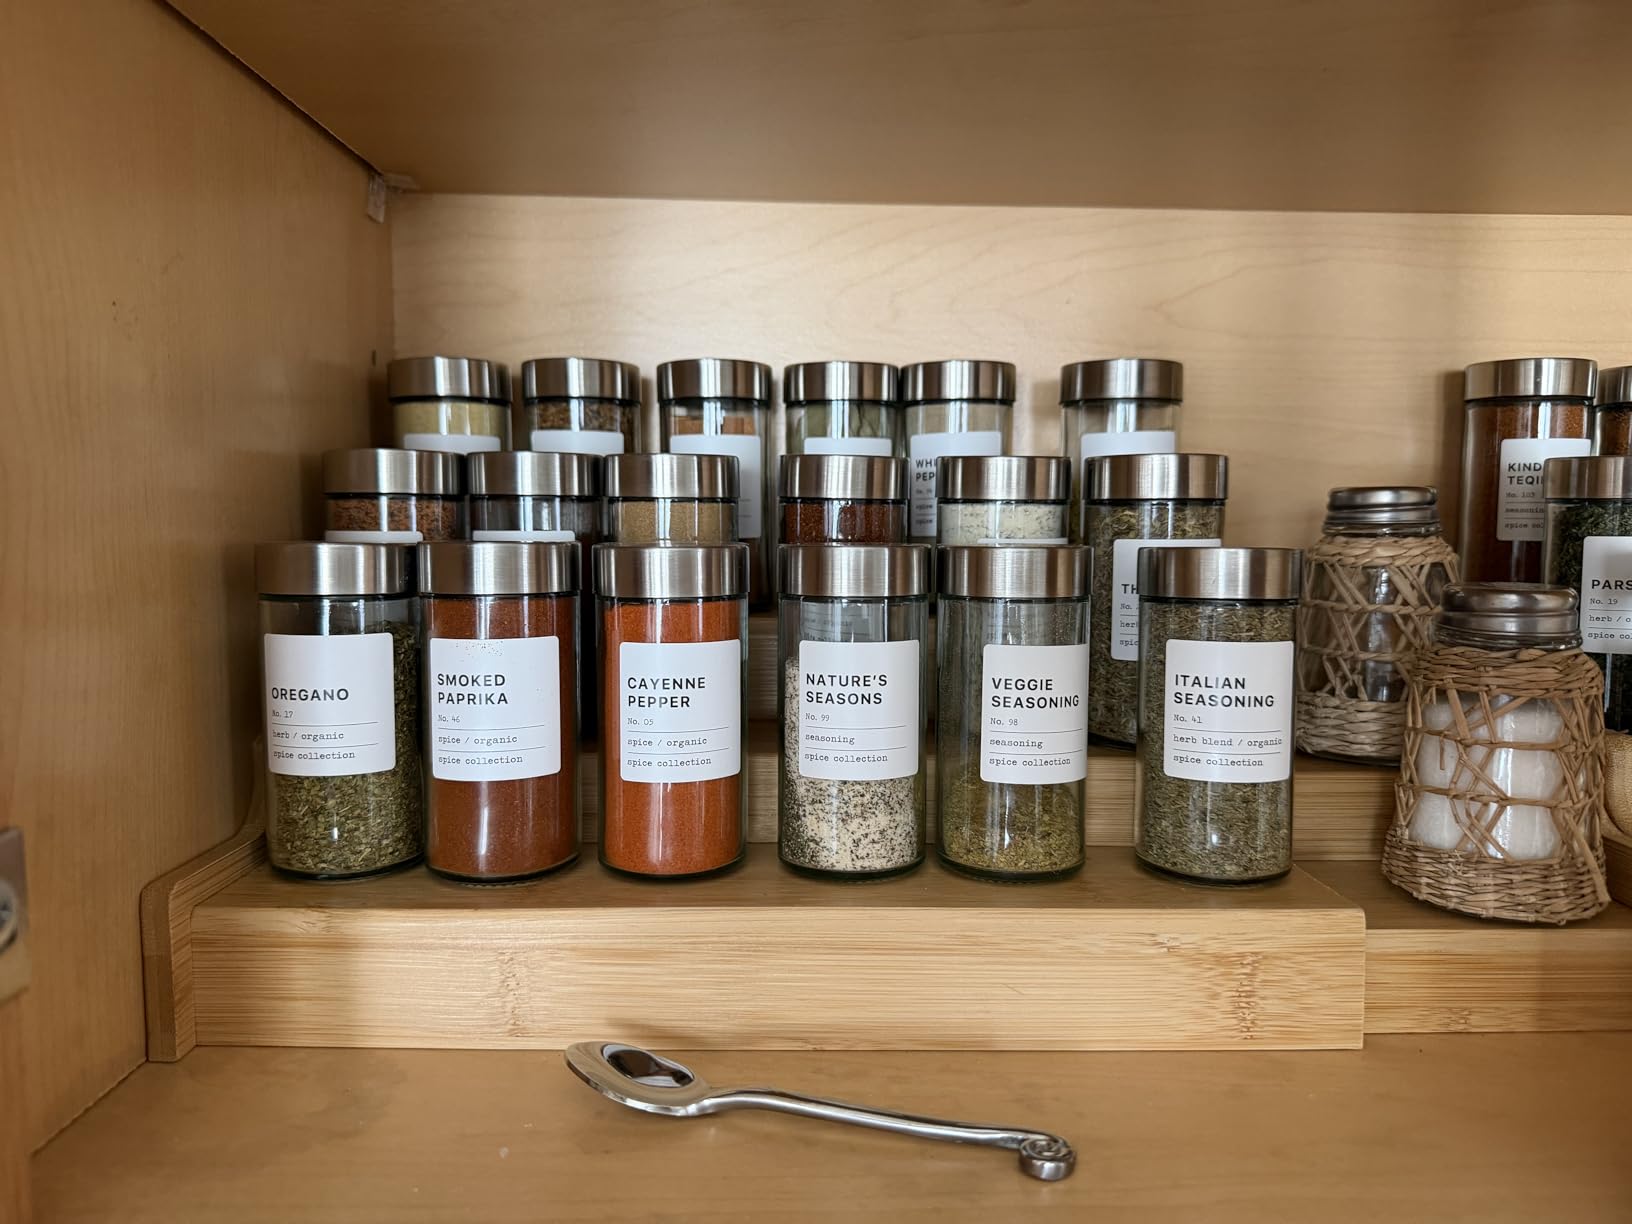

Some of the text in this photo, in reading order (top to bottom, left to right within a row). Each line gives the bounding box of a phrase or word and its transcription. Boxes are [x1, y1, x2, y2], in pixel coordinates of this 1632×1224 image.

[1507, 462, 1543, 472] KIND
[915, 472, 935, 482] PEP
[1591, 579, 1632, 590] PARS
[1587, 632, 1615, 640] spice
[437, 673, 506, 687] SMOKED
[627, 677, 706, 690] CAYENNE
[806, 673, 888, 687] NATURE'S
[991, 677, 1053, 691] VEGGIE
[1175, 674, 1246, 690] ITALIAN
[271, 687, 349, 701] OREGANO
[438, 691, 509, 705] PAPRIKA
[806, 691, 883, 705] SEASONS
[1173, 691, 1275, 708] SEASONING
[628, 695, 691, 708] PEPPER
[991, 695, 1080, 709] SEASONING
[284, 711, 294, 719] 17
[438, 714, 449, 722] No.
[805, 713, 830, 722] No. 99
[1173, 714, 1203, 724] No. 41
[627, 717, 654, 726] No. 05
[990, 718, 1019, 726] No. 98
[272, 730, 290, 739] herb
[301, 732, 345, 742] organic
[438, 735, 461, 744] spice
[474, 735, 518, 747] organic
[805, 733, 855, 745] seasoning
[1173, 734, 1197, 744] herb
[1202, 737, 1233, 746] blend
[1247, 737, 1282, 749] organic
[627, 738, 653, 747] spice
[666, 737, 708, 749] organic
[989, 739, 1043, 749] seasoning
[273, 751, 356, 760] spice collection
[438, 756, 523, 765] spice collection
[804, 753, 888, 763] spice collection
[1173, 754, 1264, 767] spice collection
[627, 757, 712, 768] spice collection
[989, 757, 1071, 767] spice collection
